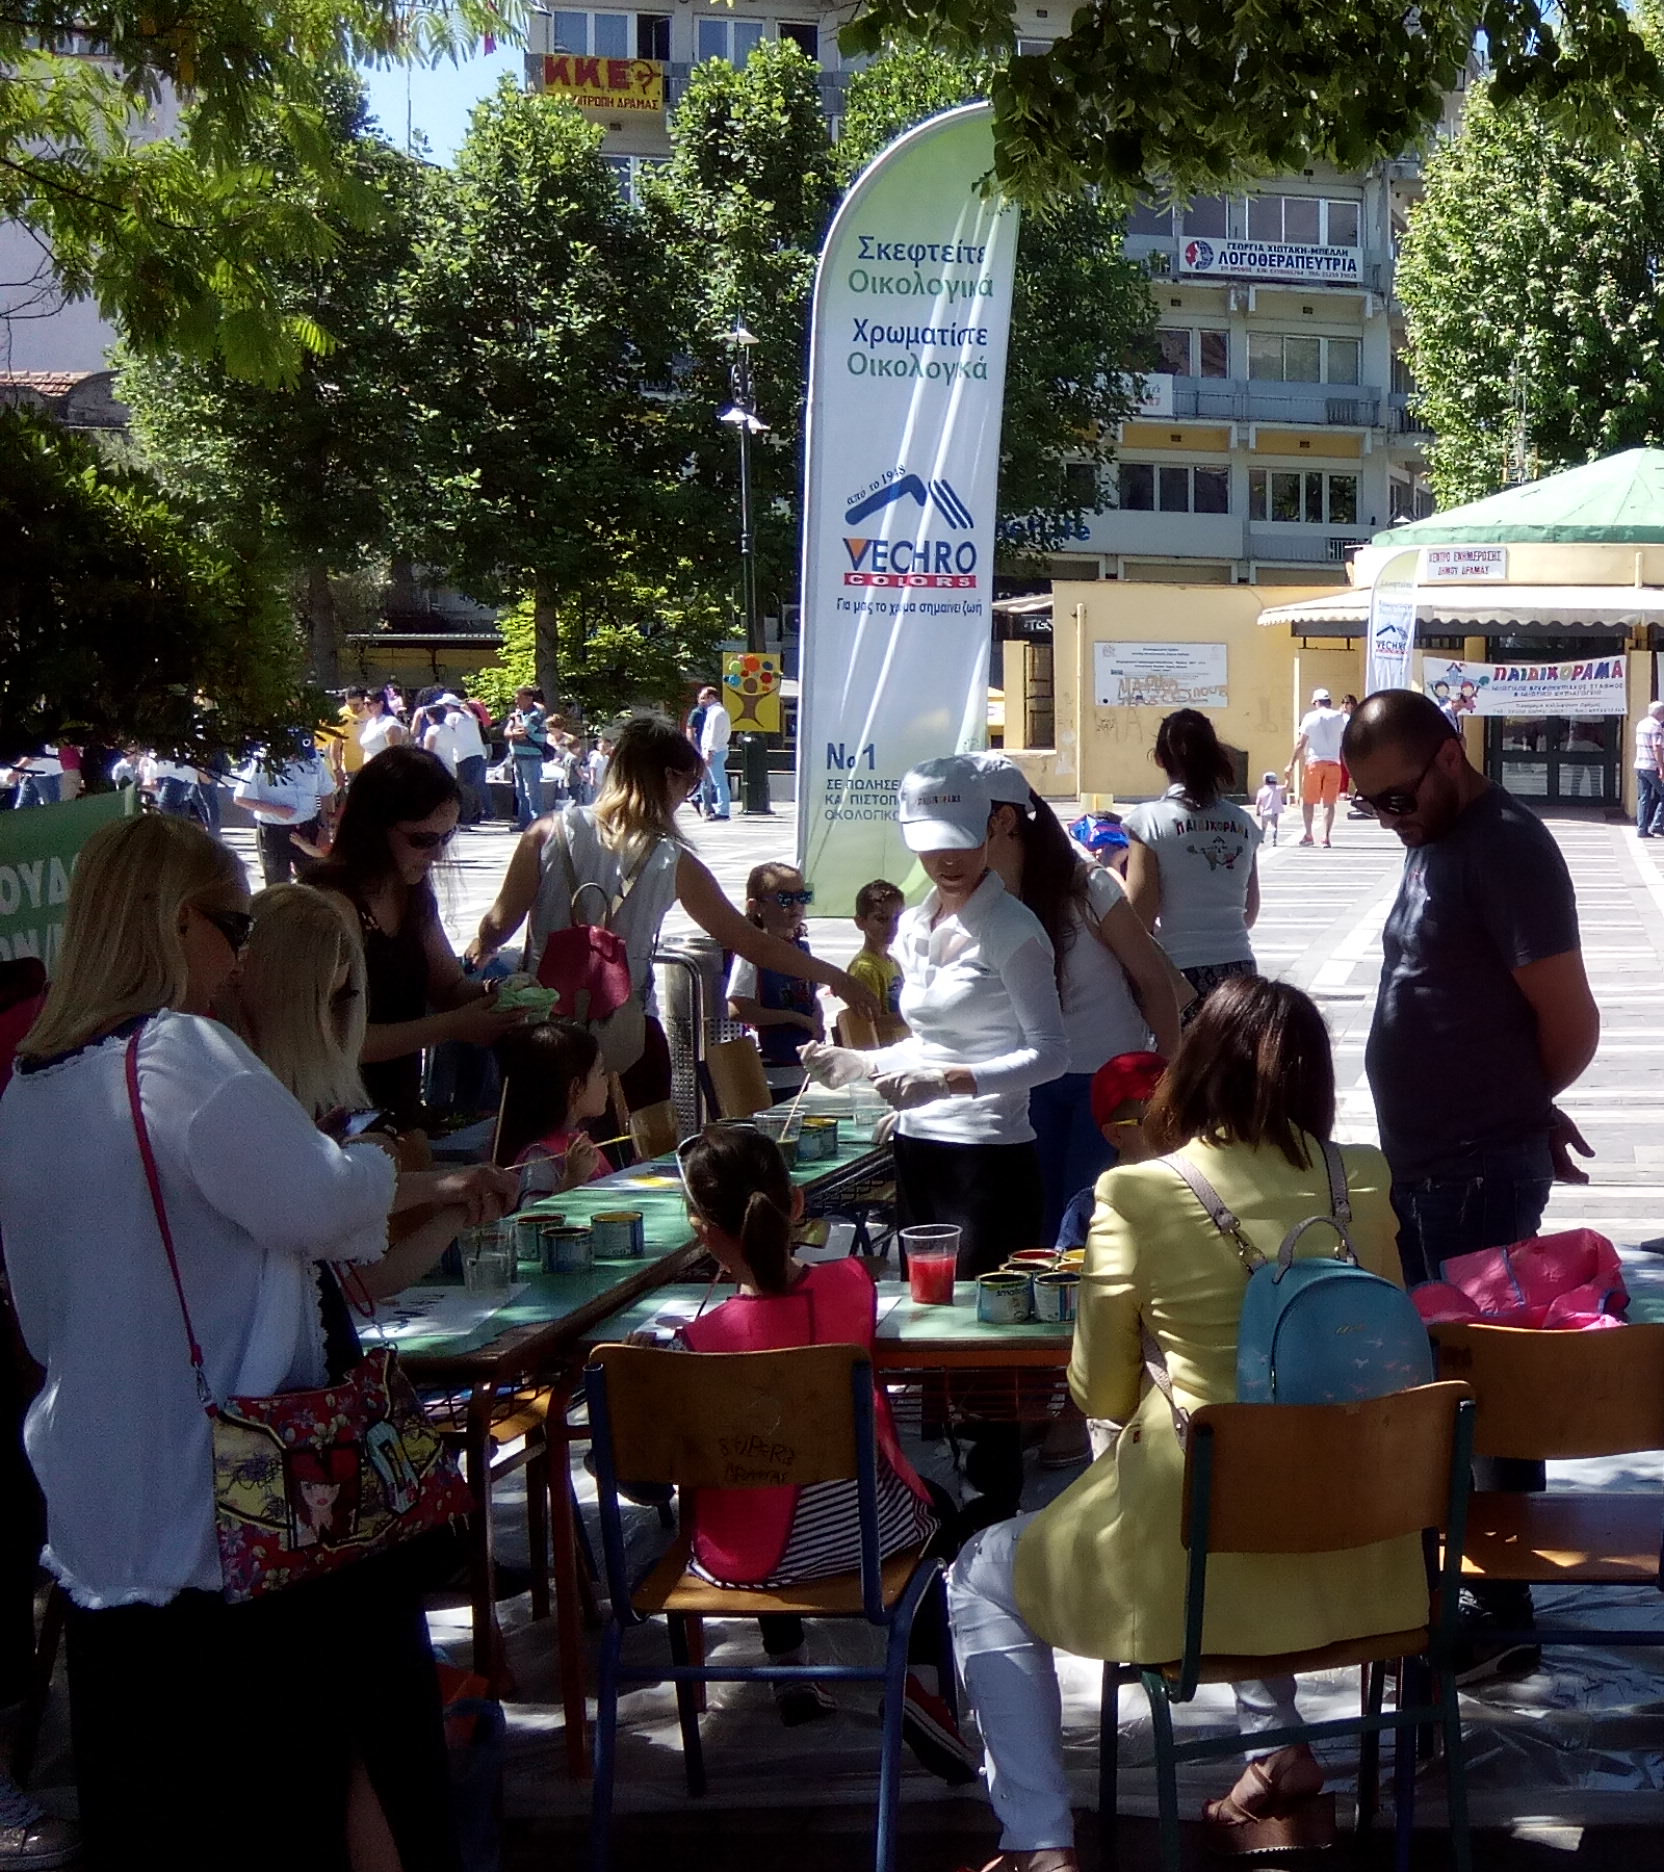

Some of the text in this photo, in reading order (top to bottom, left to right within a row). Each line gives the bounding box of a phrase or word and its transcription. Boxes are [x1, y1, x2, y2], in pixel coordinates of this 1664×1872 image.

[545, 56, 630, 89] ΚΚΕ
[617, 97, 659, 110] ΔΡΑΜΑΣ
[858, 235, 986, 268] Σκεφτείτε
[1218, 251, 1357, 272] ΛΟΓΟΘΕΡΑΠΕΥΤΡΙΑ
[849, 269, 994, 304] Οικολογικά
[853, 318, 988, 350] Χρωματίστε
[843, 538, 977, 574] VECHRO
[849, 576, 971, 587] COLORS
[890, 602, 916, 615] χμα
[1493, 659, 1624, 682] ΠΑΙΔΙΚΟΡΑΜΑ
[827, 779, 900, 790] ΣΕ ΠΩΛΗΣΕ
[825, 795, 845, 805] ΚΑ
